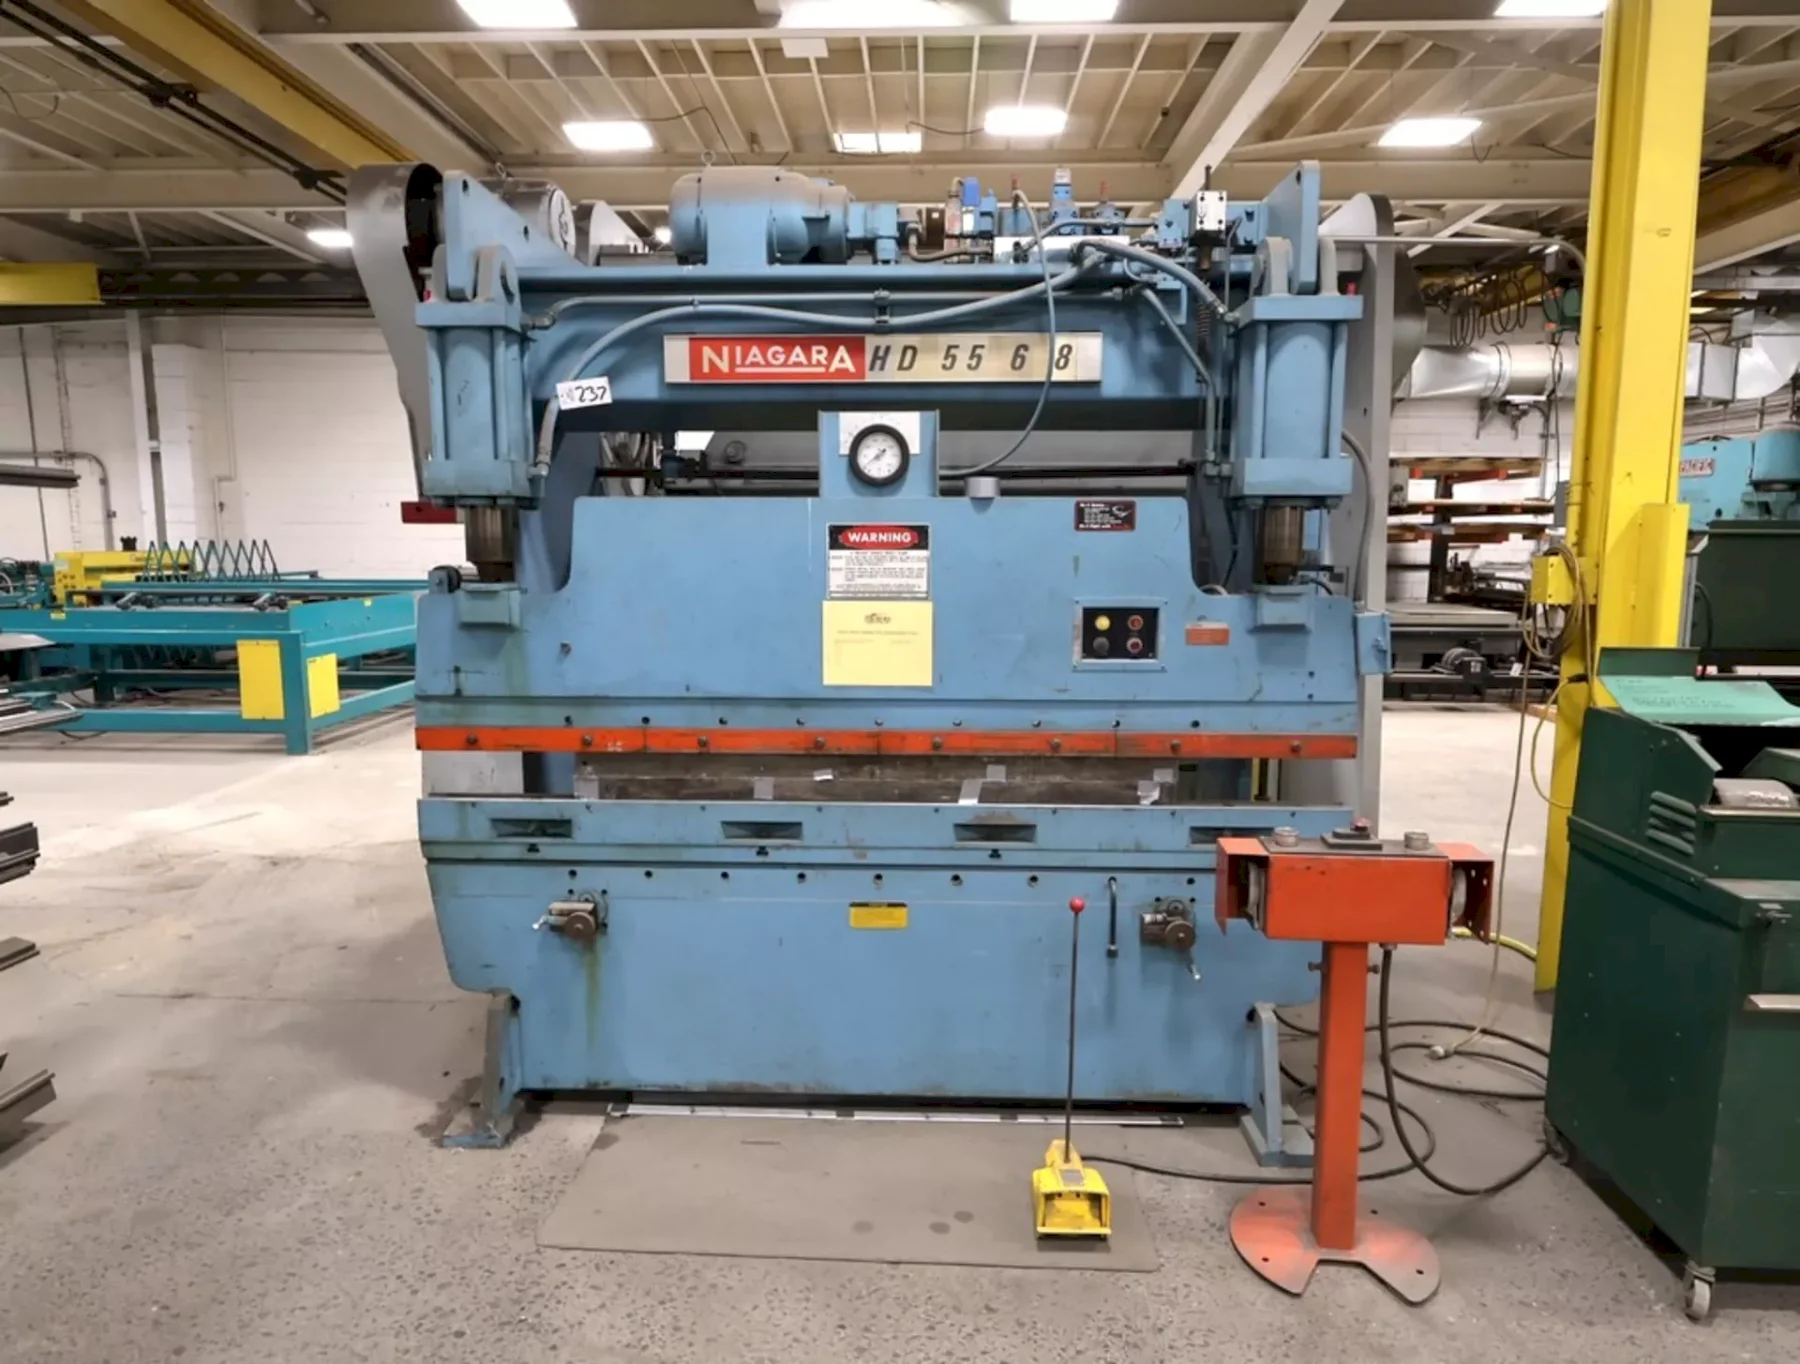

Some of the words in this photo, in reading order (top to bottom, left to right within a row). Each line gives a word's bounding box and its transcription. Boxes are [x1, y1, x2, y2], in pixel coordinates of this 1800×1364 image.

[702, 345, 856, 373] NIAGARA
[868, 345, 918, 371] HD
[941, 344, 985, 371] 55
[1010, 344, 1029, 371] 6
[1054, 344, 1073, 371] 8
[574, 385, 607, 403] 237
[847, 531, 912, 543] WARNING
